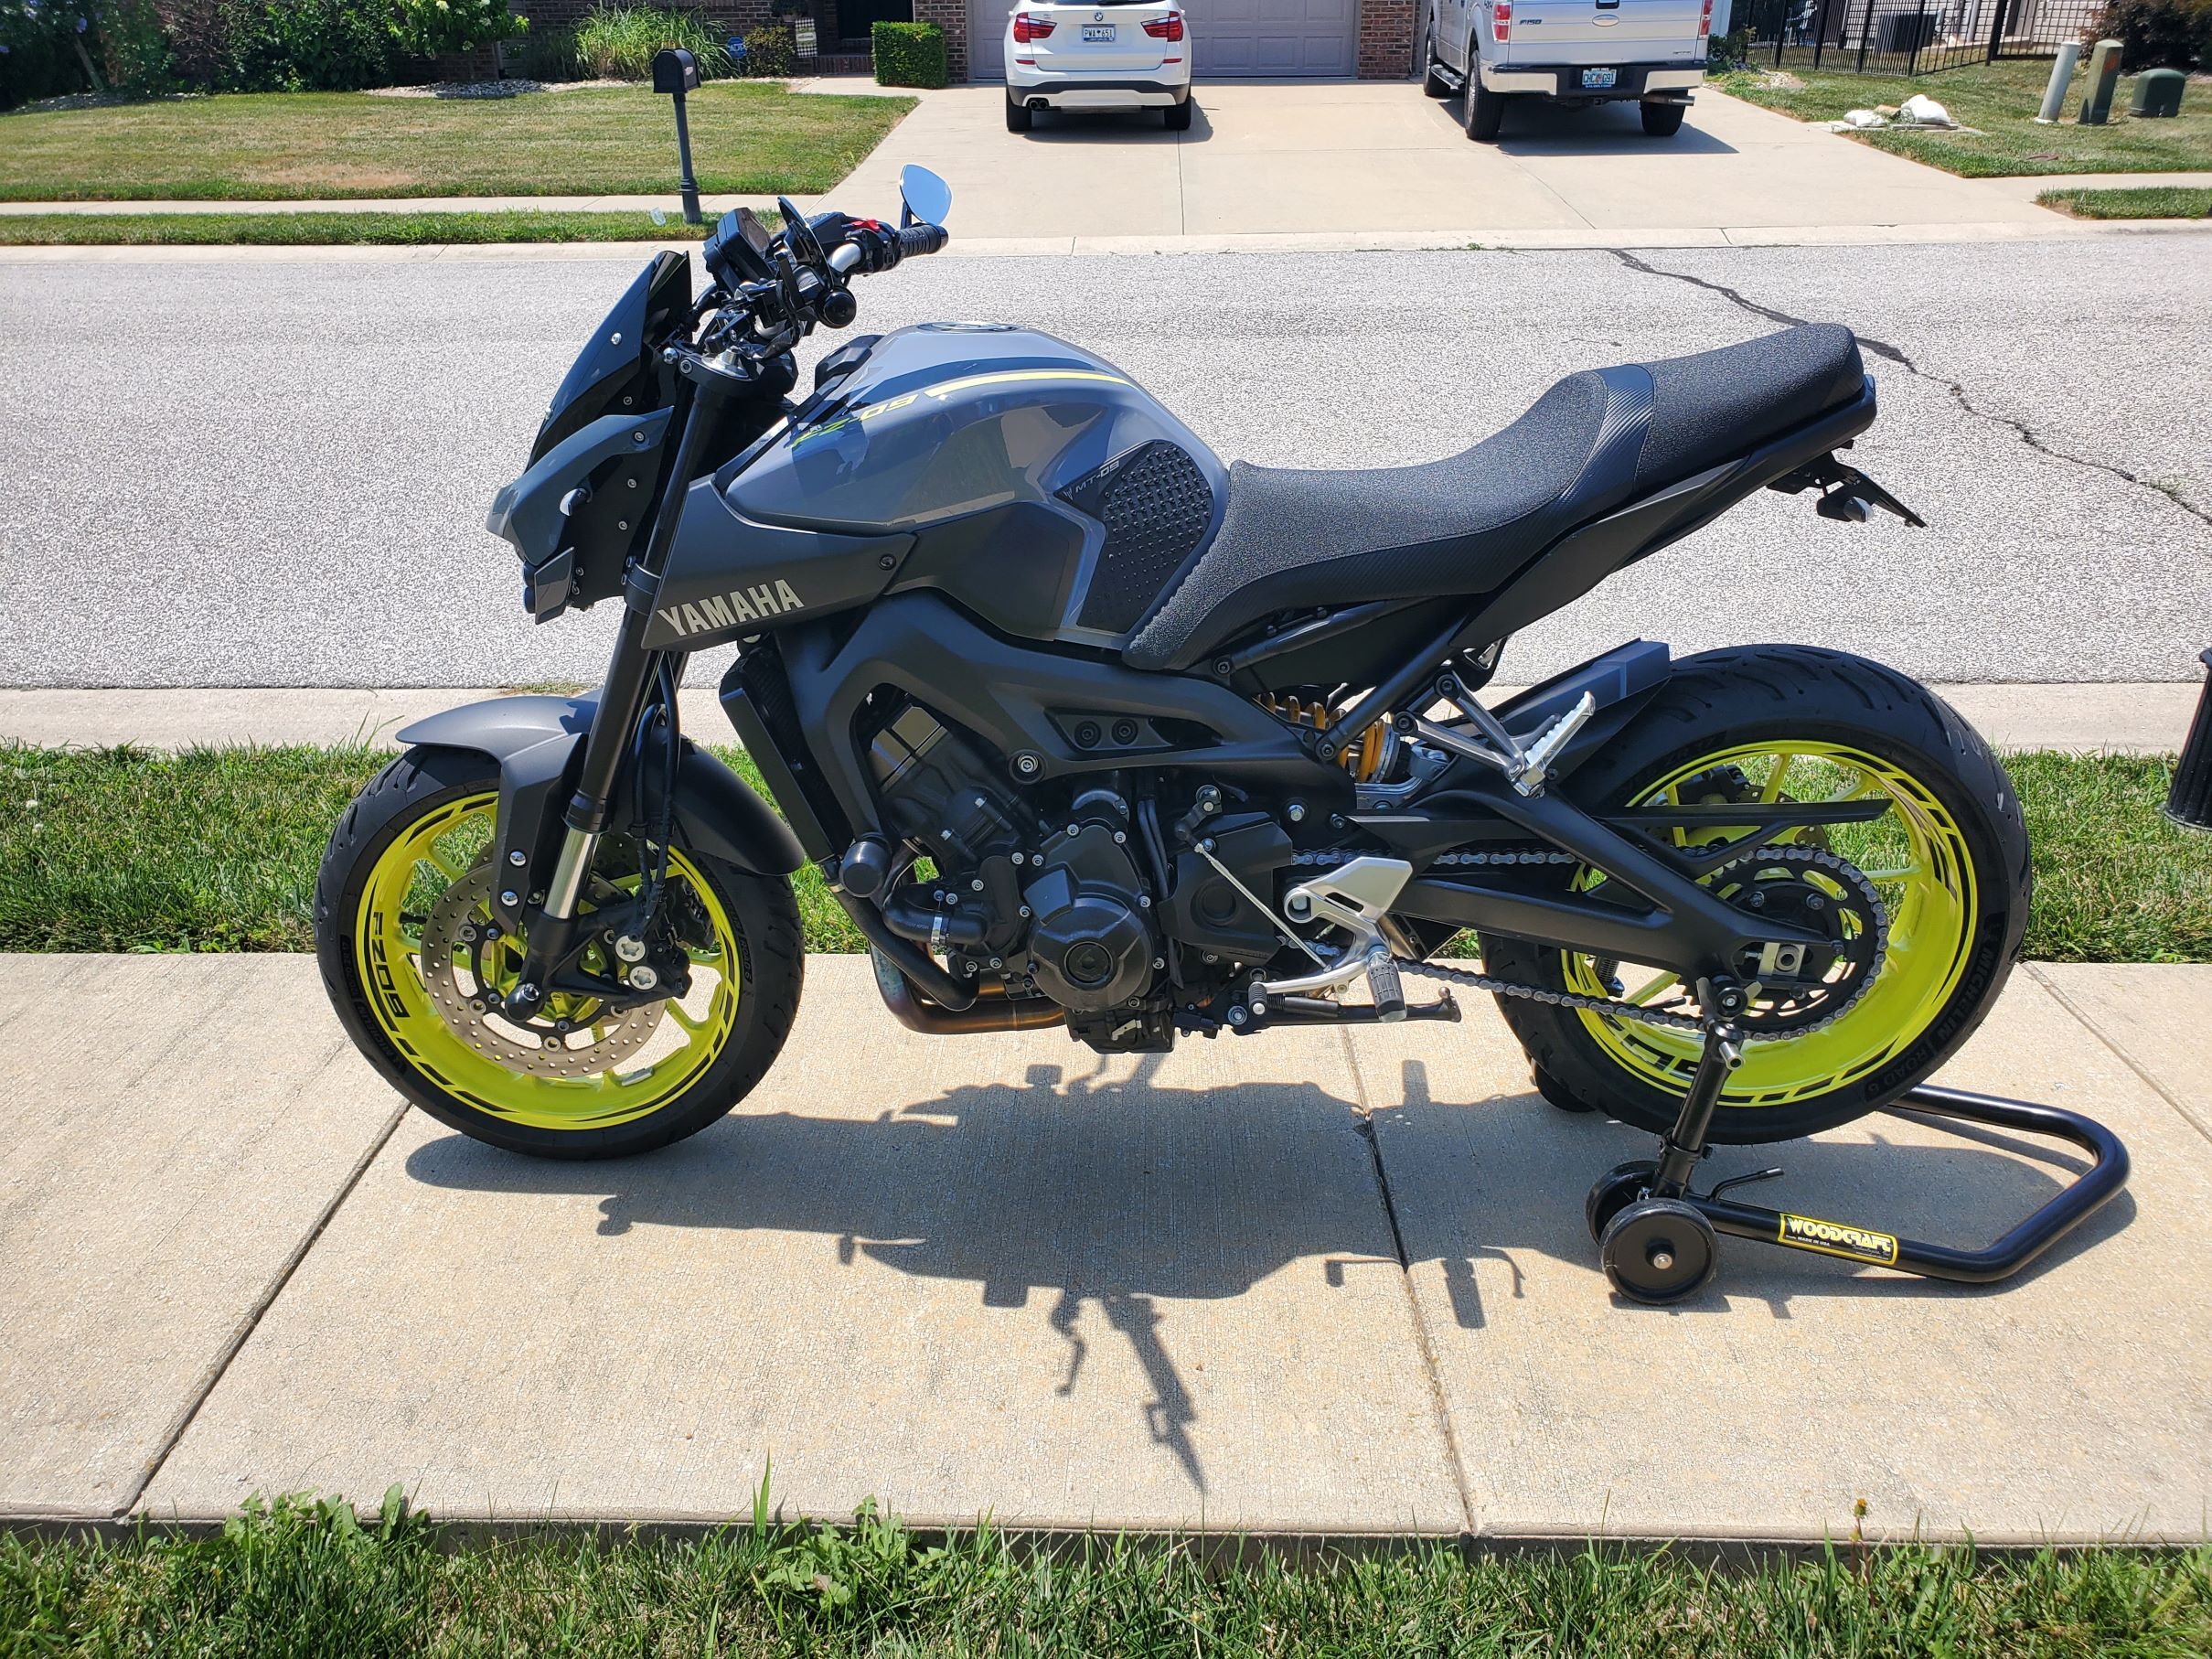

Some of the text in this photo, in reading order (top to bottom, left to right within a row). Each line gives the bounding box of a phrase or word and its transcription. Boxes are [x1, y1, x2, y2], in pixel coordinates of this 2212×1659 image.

[1101, 29, 1113, 37] 651
[1075, 460, 1120, 494] MT-09
[657, 579, 805, 637] YAMAHA
[372, 911, 411, 1019] FZ09
[1932, 946, 2000, 1043] MICHELIN
[1879, 1045, 1933, 1089] ROAD
[1787, 1217, 1891, 1252] WOODCRAFT
